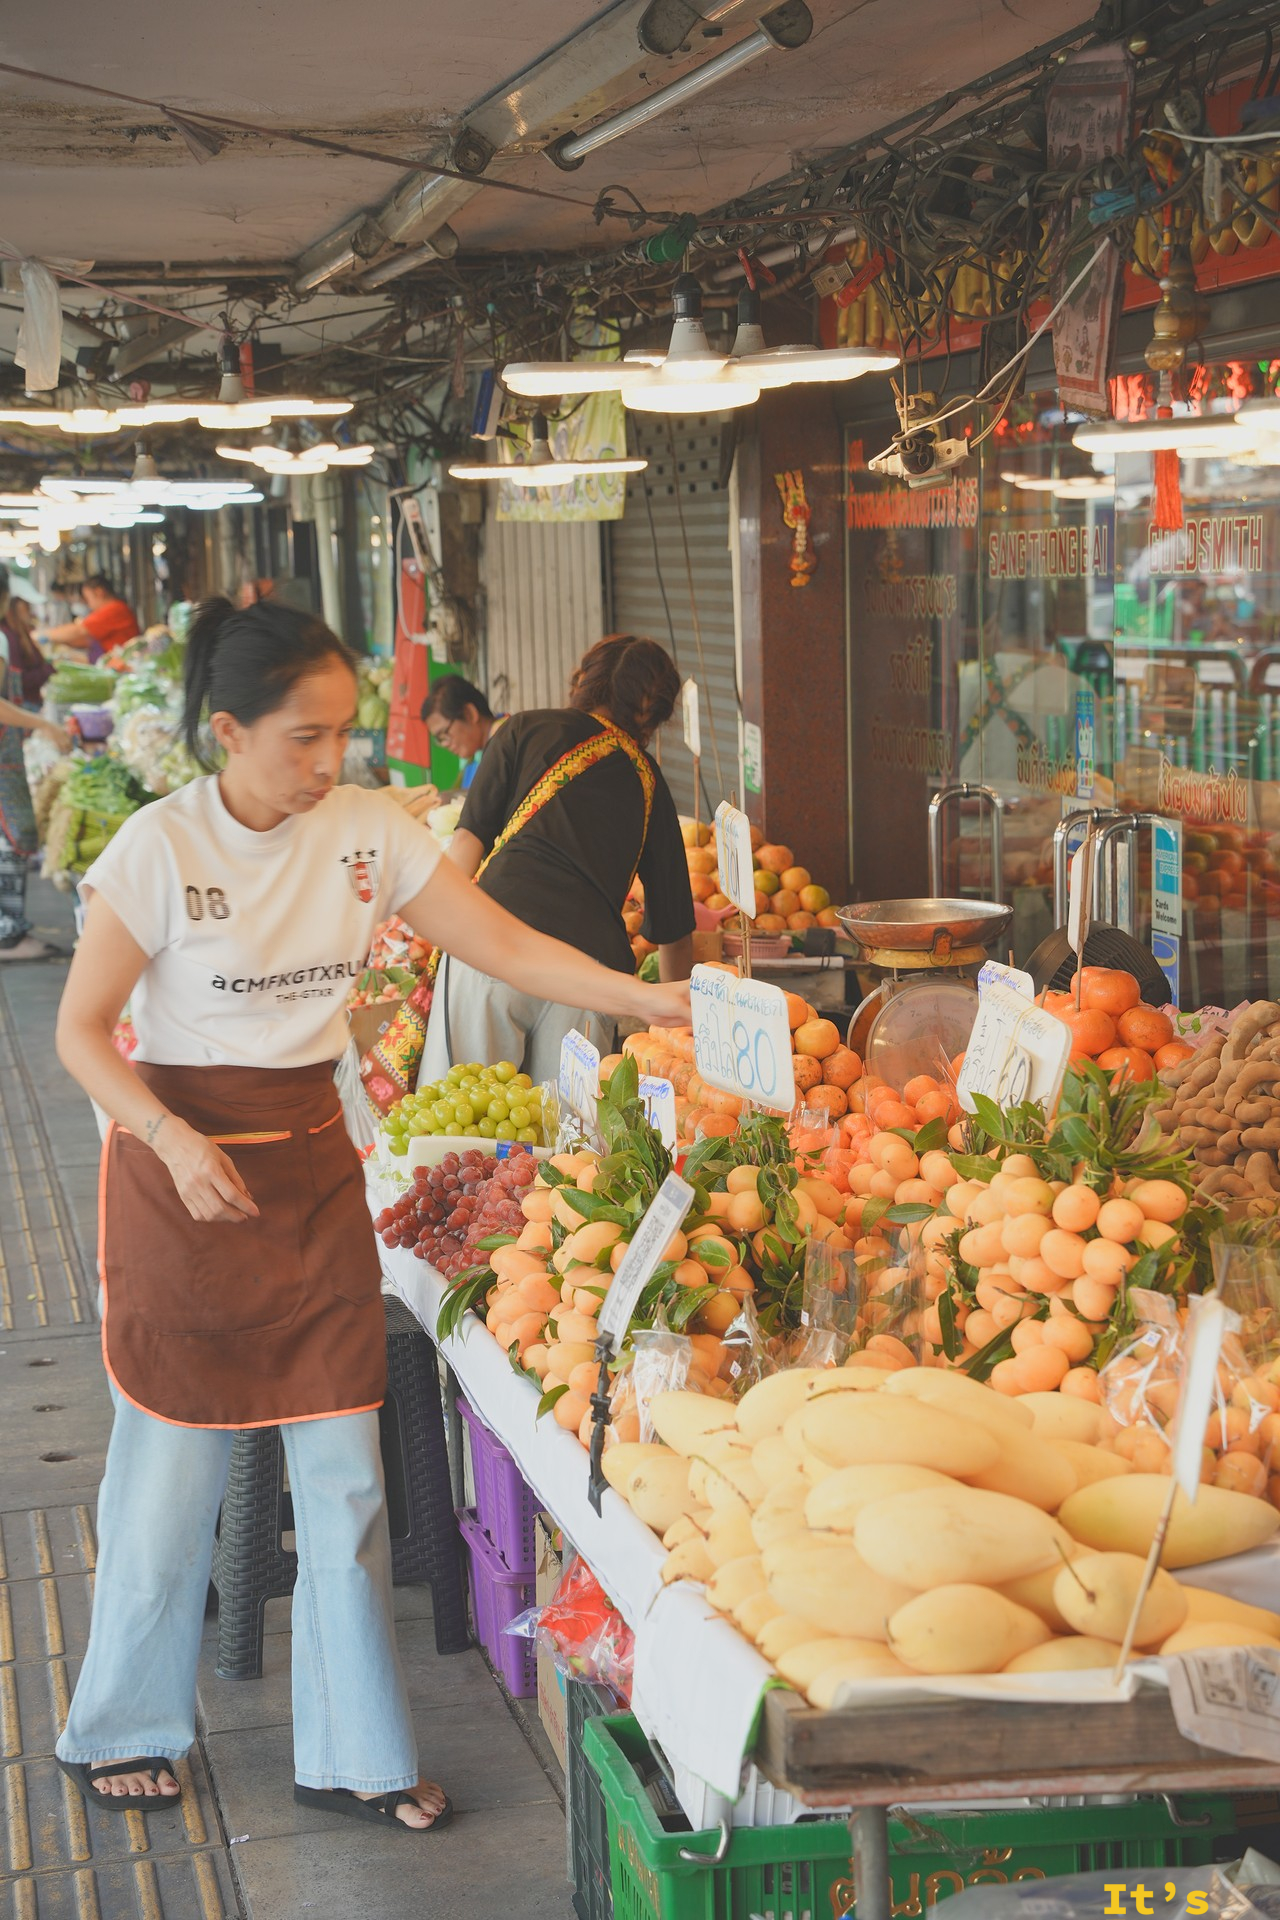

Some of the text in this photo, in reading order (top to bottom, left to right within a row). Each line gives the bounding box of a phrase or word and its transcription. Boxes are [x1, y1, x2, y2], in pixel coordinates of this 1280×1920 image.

[989, 524, 1108, 579] SANG THONG BAI
[1149, 515, 1263, 574] GOLDSMITH
[1155, 898, 1169, 912] Cards
[1155, 910, 1177, 926] Welcome
[732, 1020, 777, 1097] 80
